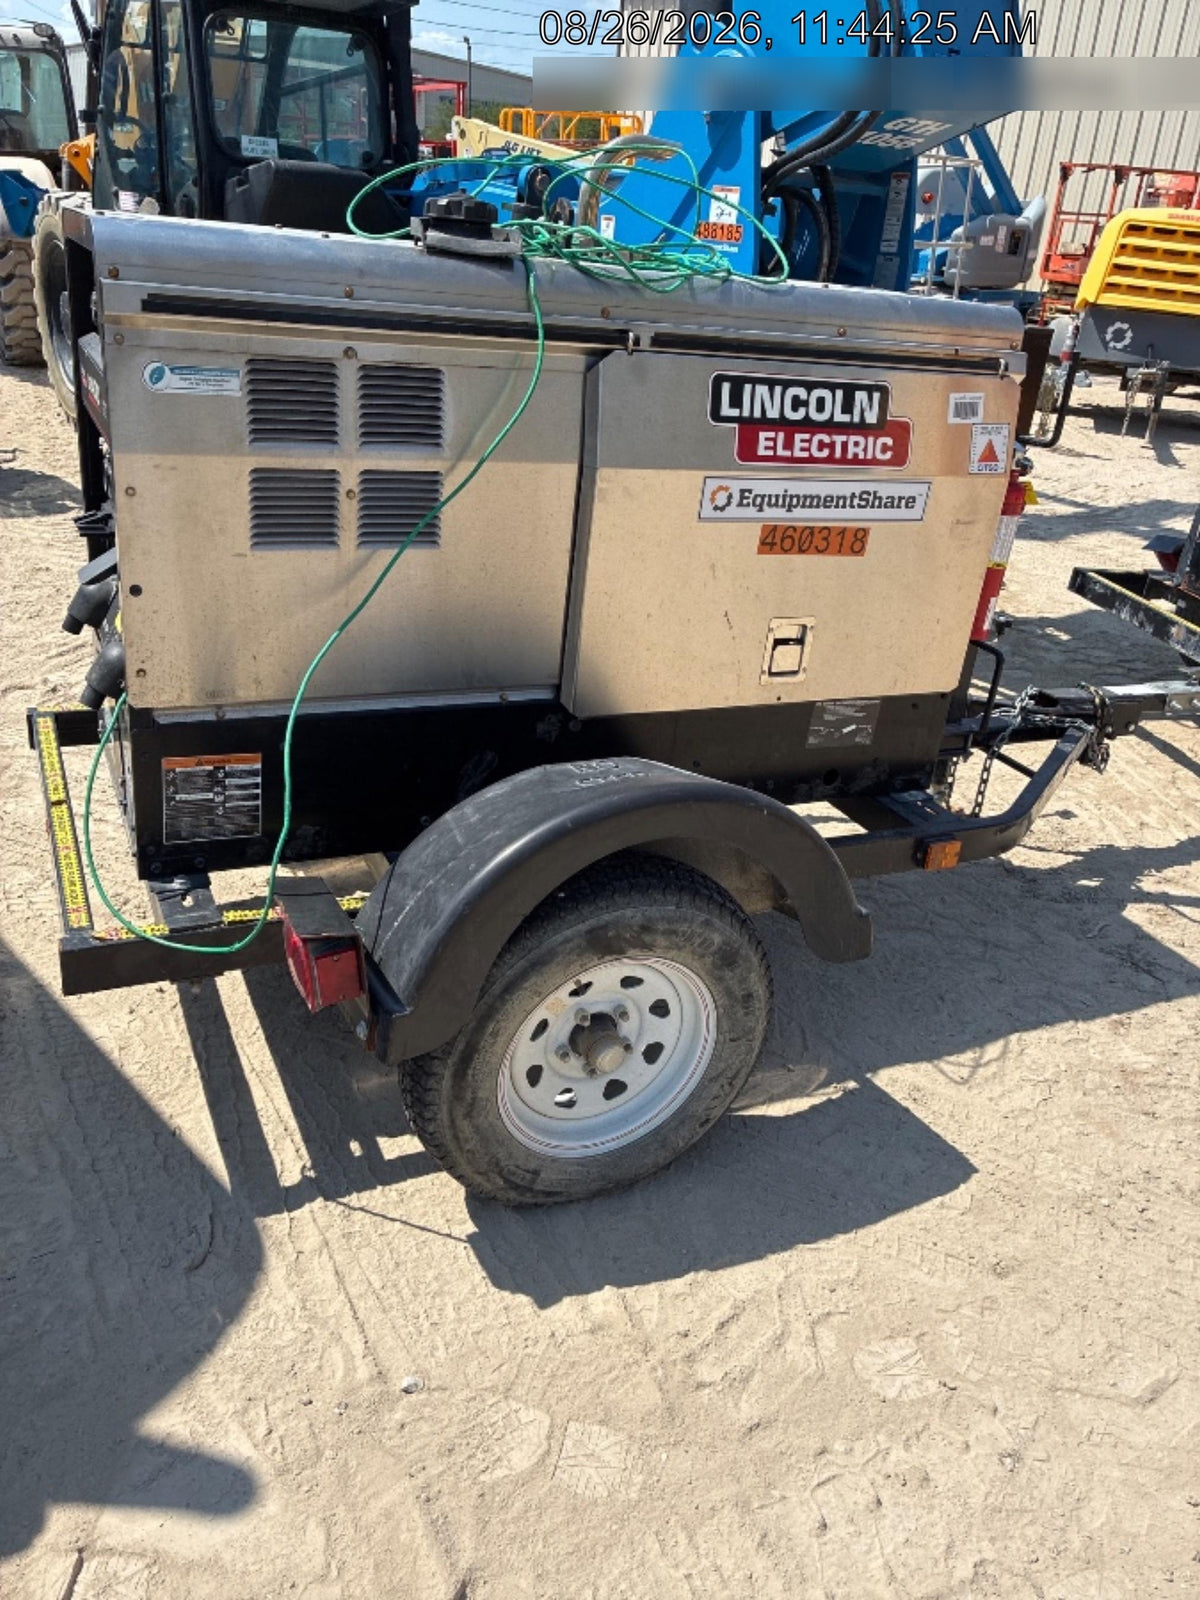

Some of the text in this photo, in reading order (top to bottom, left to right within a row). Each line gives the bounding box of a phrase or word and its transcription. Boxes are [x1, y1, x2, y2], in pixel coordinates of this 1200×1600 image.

[720, 381, 881, 424] LINCOLN
[757, 431, 893, 460] ELECTRIC
[736, 488, 917, 513] EquipmentShare
[760, 524, 869, 554] 460318
